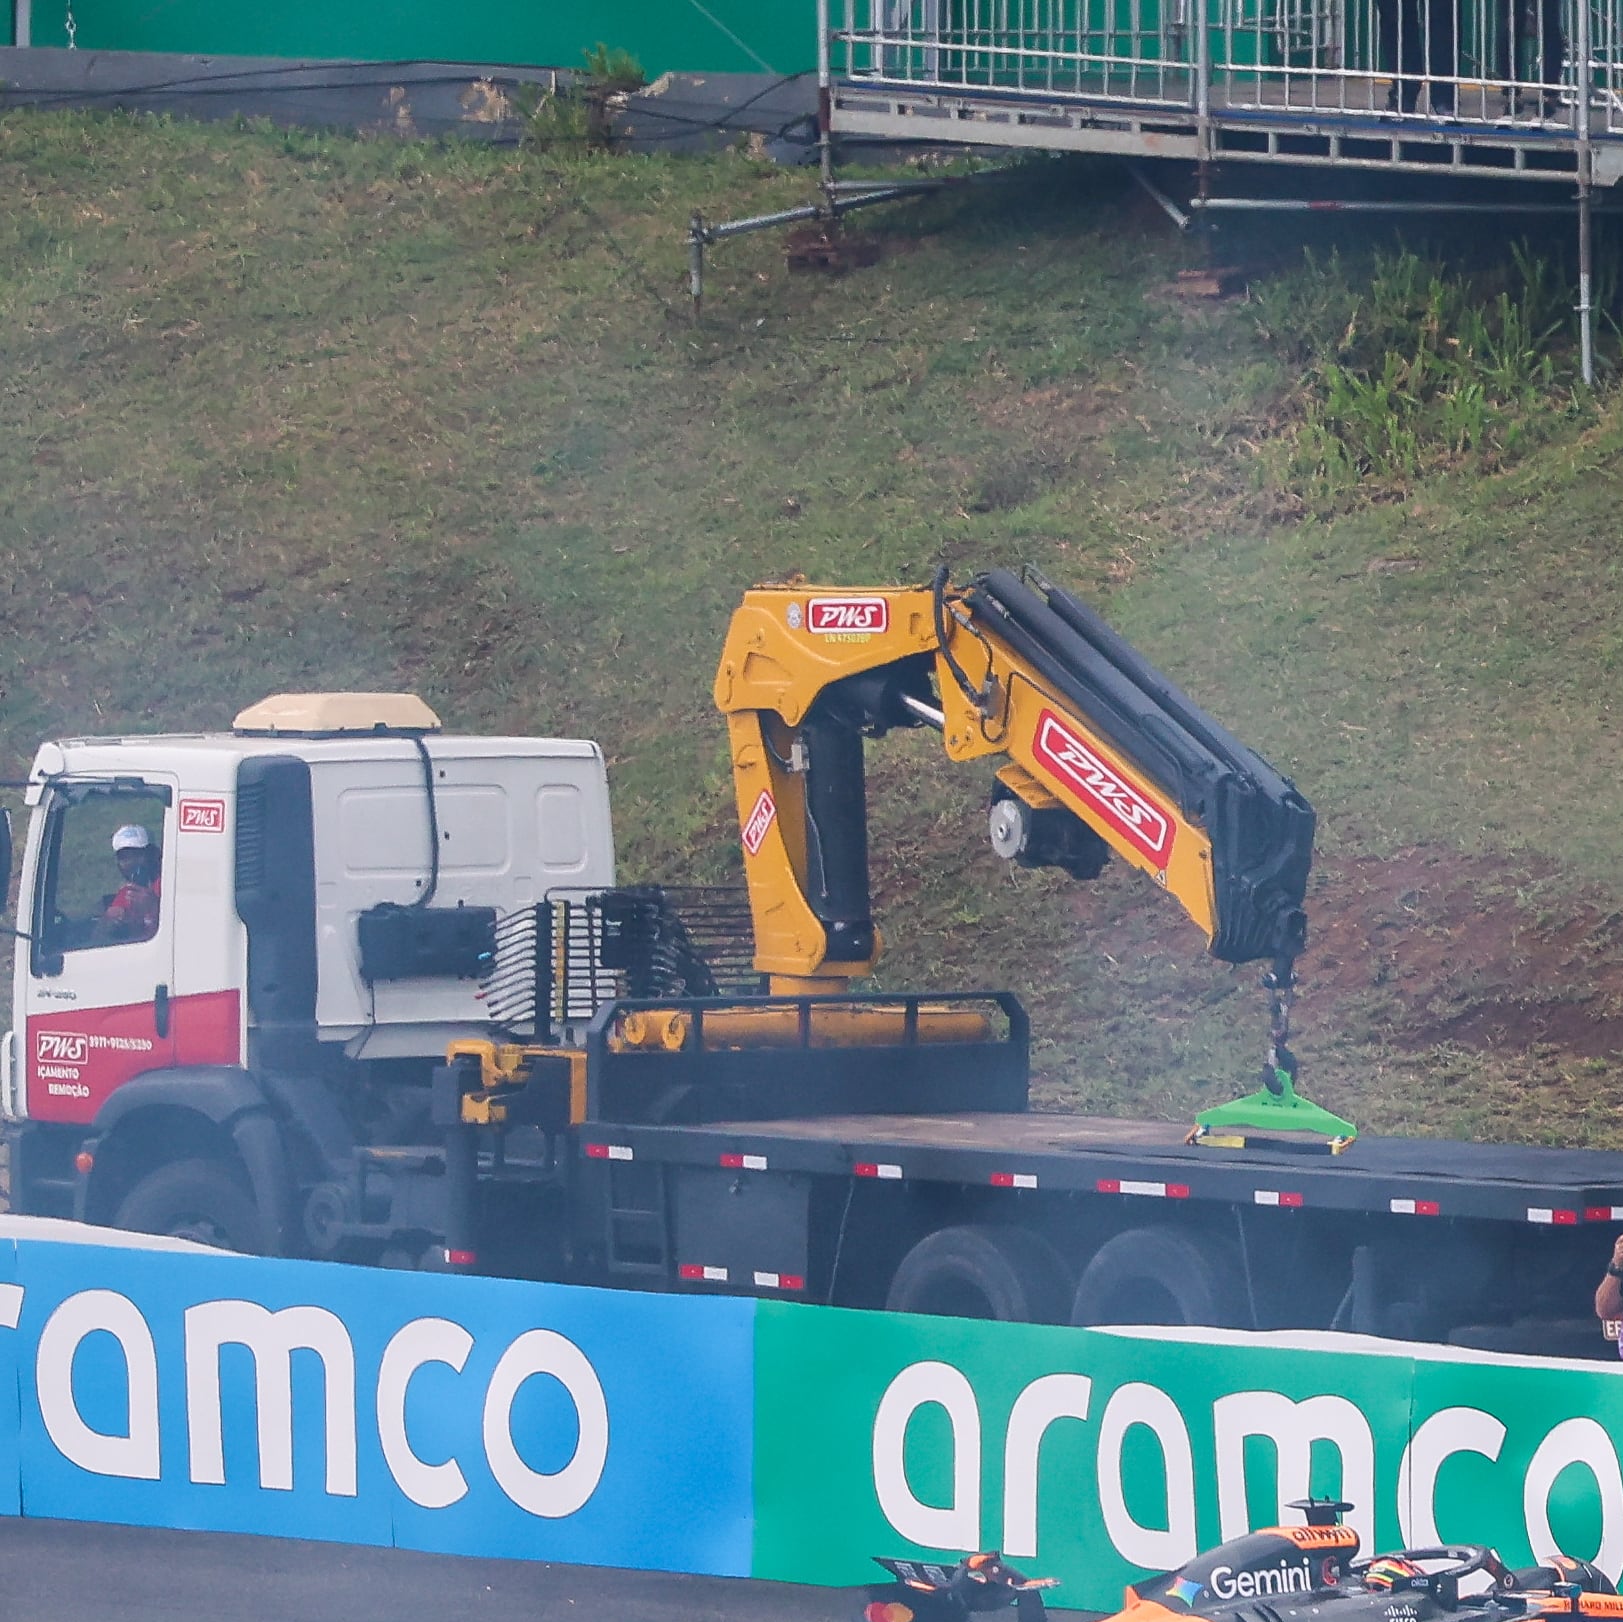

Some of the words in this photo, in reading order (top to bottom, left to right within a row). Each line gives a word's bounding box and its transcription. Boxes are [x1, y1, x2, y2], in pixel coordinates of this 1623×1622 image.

[820, 606, 878, 627] PWS
[1058, 743, 1152, 825] PWS
[40, 1036, 86, 1059] PWS
[48, 1083, 90, 1097] REMOÇÃO
[0, 1282, 609, 1518] amco
[1211, 1557, 1312, 1599] Gemini
